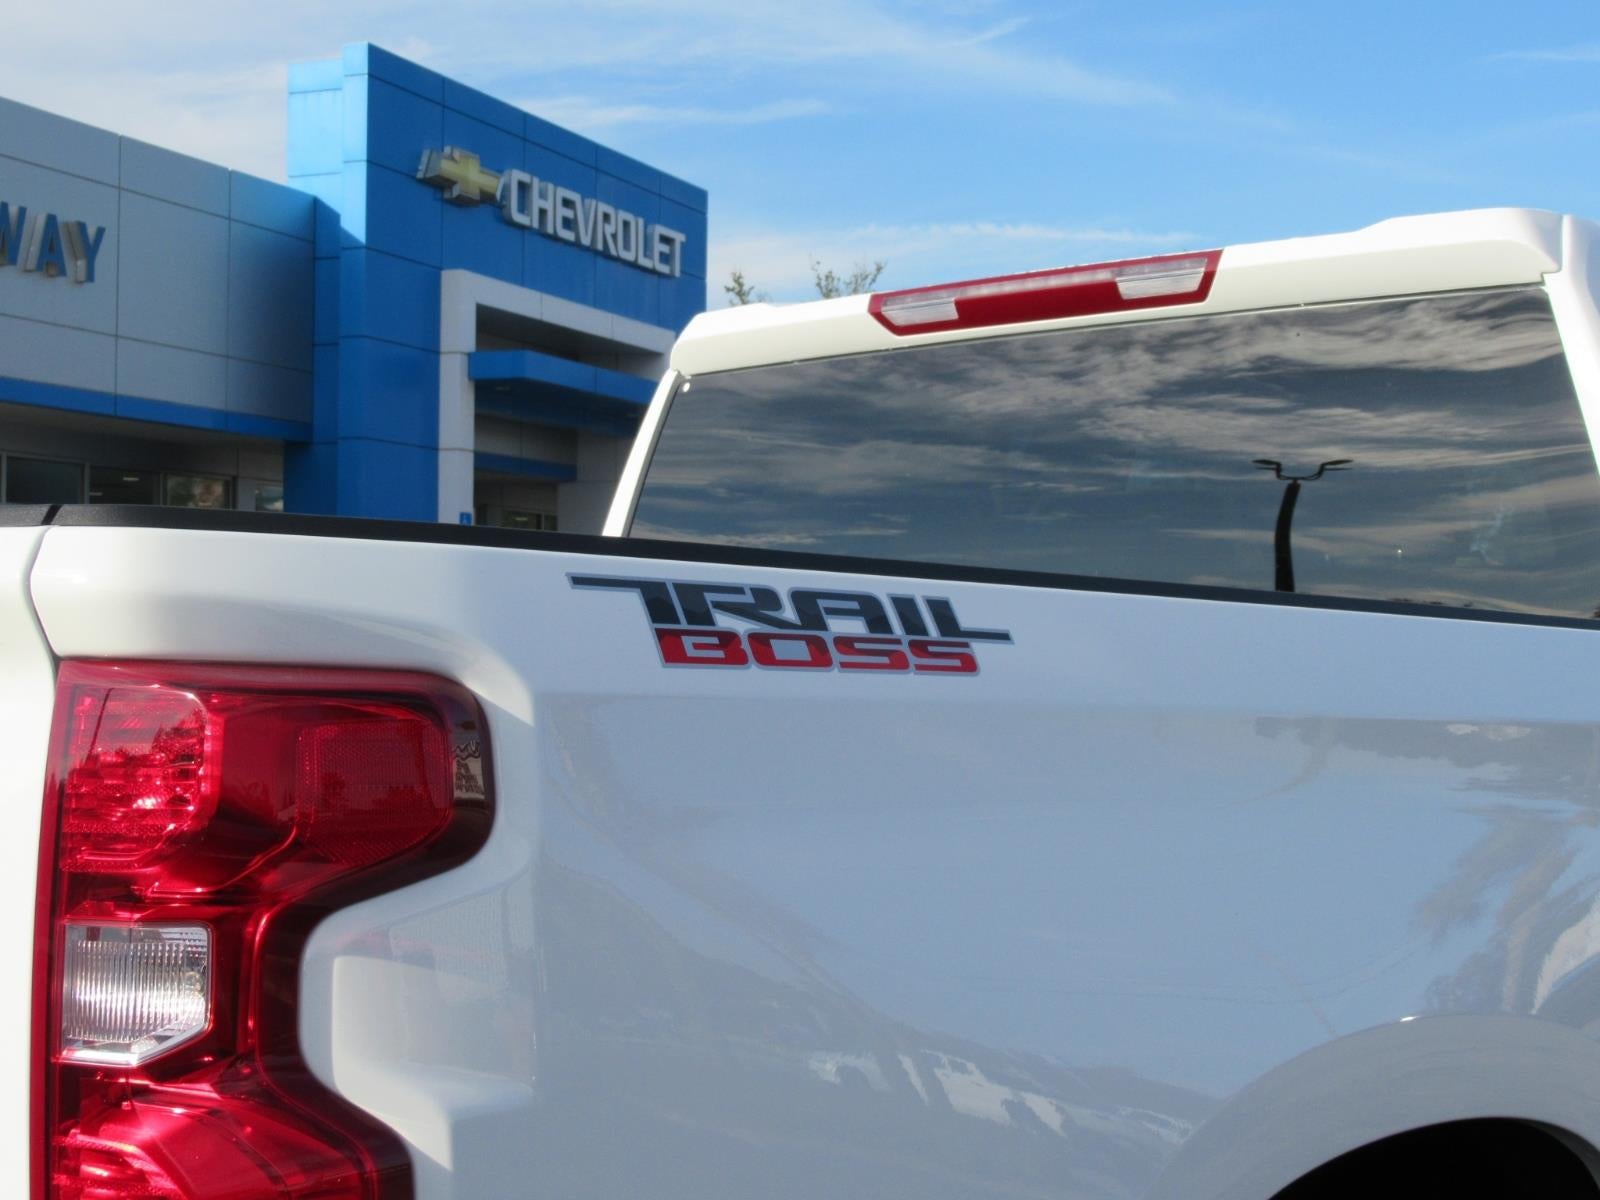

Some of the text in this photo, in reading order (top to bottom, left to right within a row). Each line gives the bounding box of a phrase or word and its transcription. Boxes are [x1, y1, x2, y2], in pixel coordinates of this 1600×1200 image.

[503, 169, 686, 277] CHEVROLET
[569, 574, 1013, 643] TRAIL
[654, 626, 979, 674] BOSS
